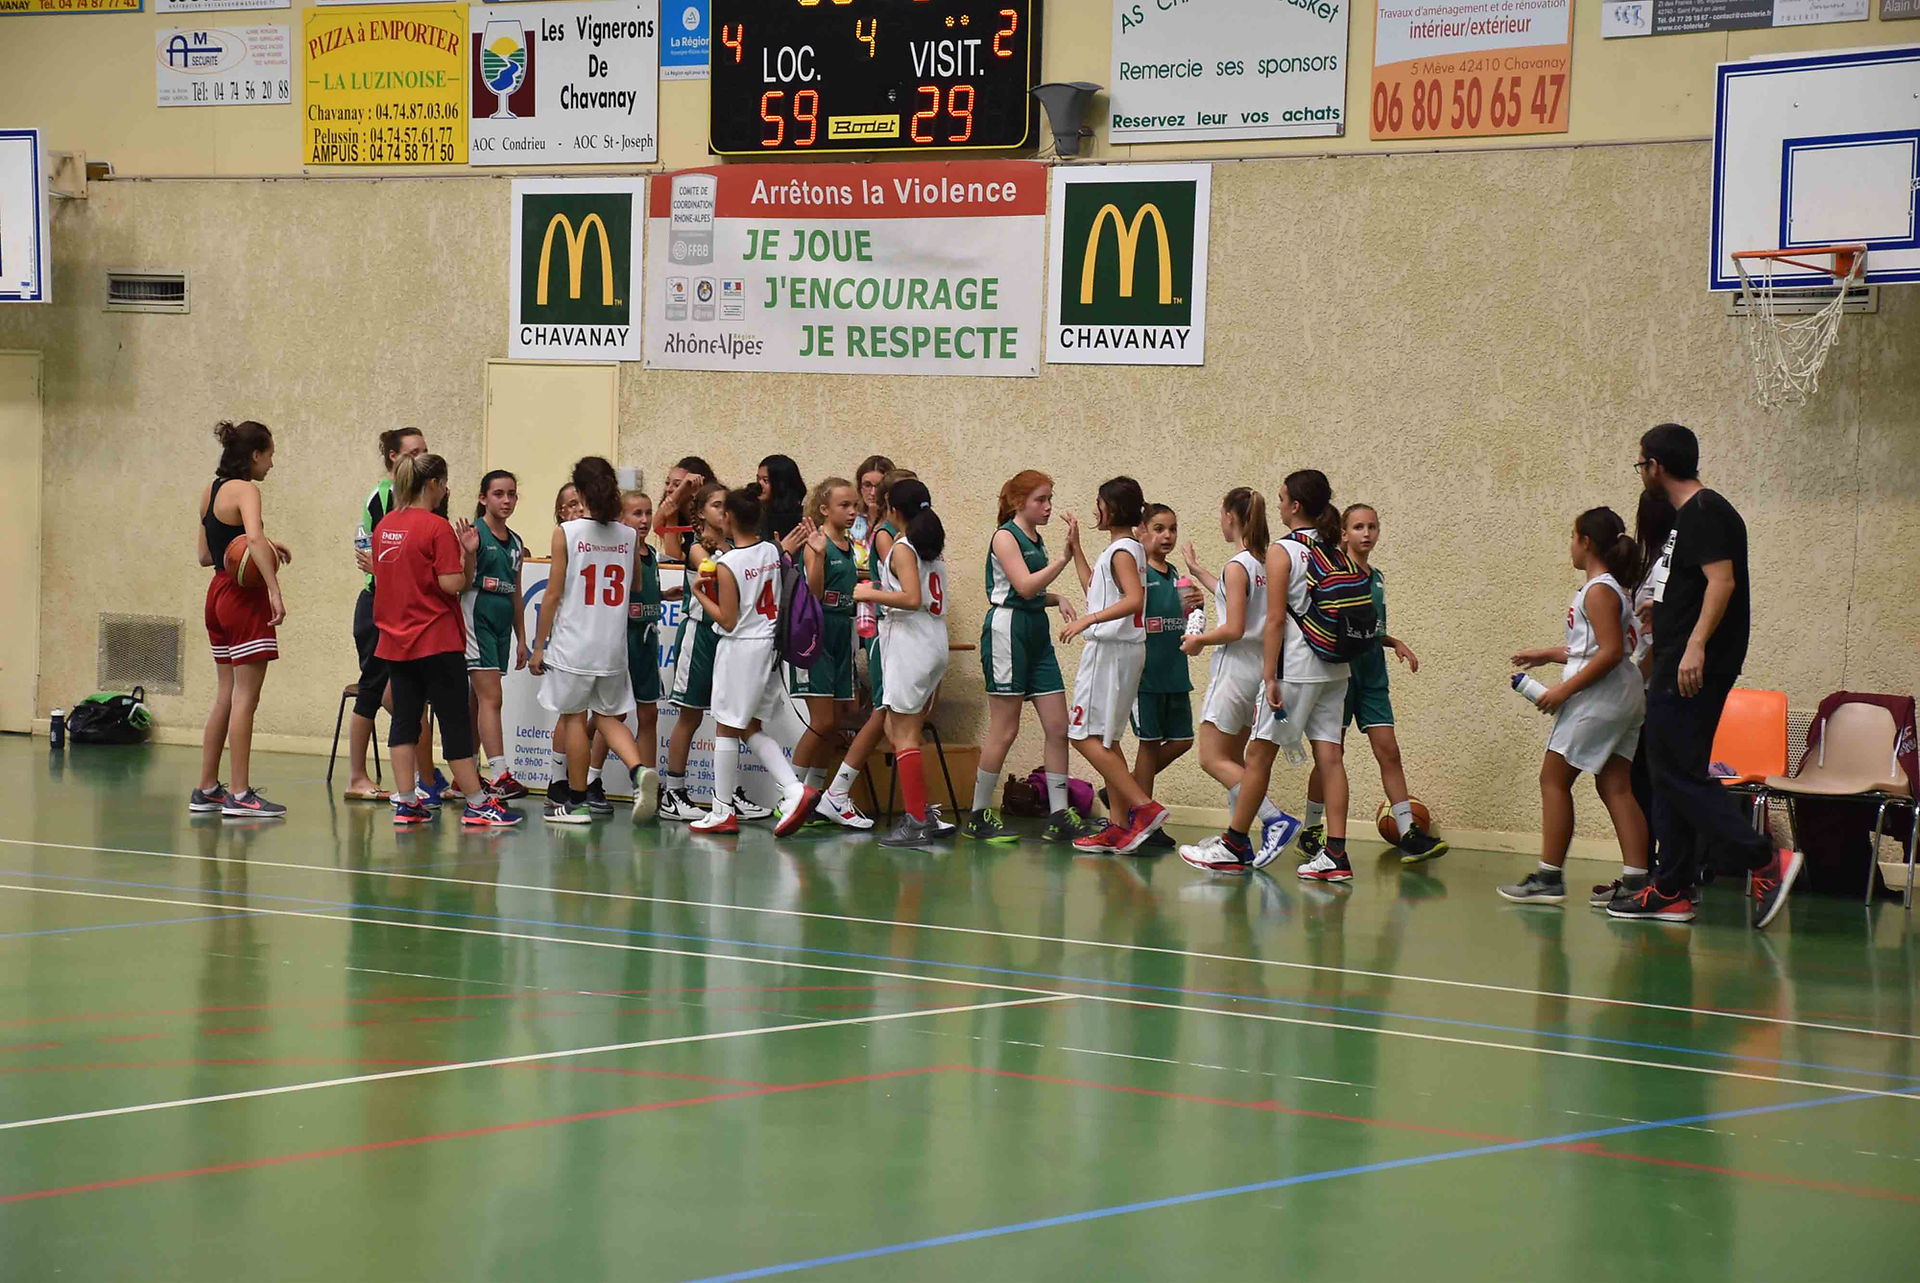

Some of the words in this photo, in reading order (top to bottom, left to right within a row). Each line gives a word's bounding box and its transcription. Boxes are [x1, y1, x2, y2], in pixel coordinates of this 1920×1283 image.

[1120, 4, 1144, 34] AS
[1277, 0, 1340, 23] asket
[1380, 8, 1413, 19] Travaux
[1414, 2, 1489, 18] d'aménagement
[1490, 2, 1499, 12] et
[1502, 0, 1514, 11] de
[308, 26, 354, 60] PIZZA
[370, 20, 460, 56] EMPORTER
[542, 18, 564, 42] Les
[576, 14, 654, 47] Vignerons
[855, 18, 878, 58] 4
[993, 9, 1018, 56] 2
[1409, 16, 1532, 40] intérieur/extérieur
[671, 37, 680, 47] La
[722, 24, 744, 63] 4
[588, 54, 608, 78] De
[762, 46, 822, 84] LOC.
[910, 39, 985, 78] VISIT.
[1120, 59, 1203, 80] Remercie
[1216, 60, 1244, 76] ses
[1258, 54, 1338, 78] sponsors
[1410, 64, 1419, 76] 5
[1459, 58, 1500, 72] 42410
[1504, 56, 1567, 72] Chavanay
[214, 82, 224, 100] 04
[230, 82, 238, 100] 74
[246, 81, 255, 100] 56
[262, 80, 272, 99] 20
[279, 80, 288, 99] 88
[324, 72, 346, 90] LA
[352, 70, 446, 90] LUZINOISE
[560, 84, 636, 115] Chavanay
[911, 84, 975, 142] 29
[1374, 81, 1404, 133] 06
[1412, 78, 1442, 132] 80
[1451, 76, 1482, 130] 50
[1490, 76, 1522, 129] 65
[1531, 74, 1566, 125] 47
[308, 104, 364, 124] Chavanay
[376, 103, 458, 120] 04.74.87.03.06
[760, 90, 818, 146] 59
[832, 119, 896, 135] Bodet
[1112, 114, 1185, 128] Reservez
[1197, 112, 1228, 126] leur
[1240, 110, 1269, 124] vos
[1282, 106, 1340, 122] achats
[314, 128, 358, 144] Pelussin
[370, 127, 452, 144] 04.74.57.61.77
[472, 137, 496, 151] AOC
[502, 136, 546, 151] Condrieu
[574, 135, 598, 149] AOC
[312, 144, 358, 162] AMPUIS
[370, 144, 384, 162] 04
[387, 144, 400, 162] 74
[404, 144, 418, 162] 58
[422, 144, 434, 161] 71
[440, 144, 454, 162] 50
[700, 186, 708, 196] DE
[750, 179, 852, 206] Arrêtons
[862, 179, 884, 206] la
[894, 178, 1017, 204] Violence
[674, 200, 712, 210] COORDINATION
[742, 228, 780, 261] JE
[788, 228, 873, 262] JOUE
[764, 276, 999, 310] J'ENCOURAGE
[520, 326, 630, 347] CHAVANAY
[800, 325, 835, 358] JE
[847, 326, 1018, 359] RESPECTE
[1060, 328, 1191, 350] CHAVANAY
[580, 564, 625, 606] 13
[928, 571, 943, 616] 9
[756, 578, 778, 620] 4
[515, 744, 552, 756] Ouverture
